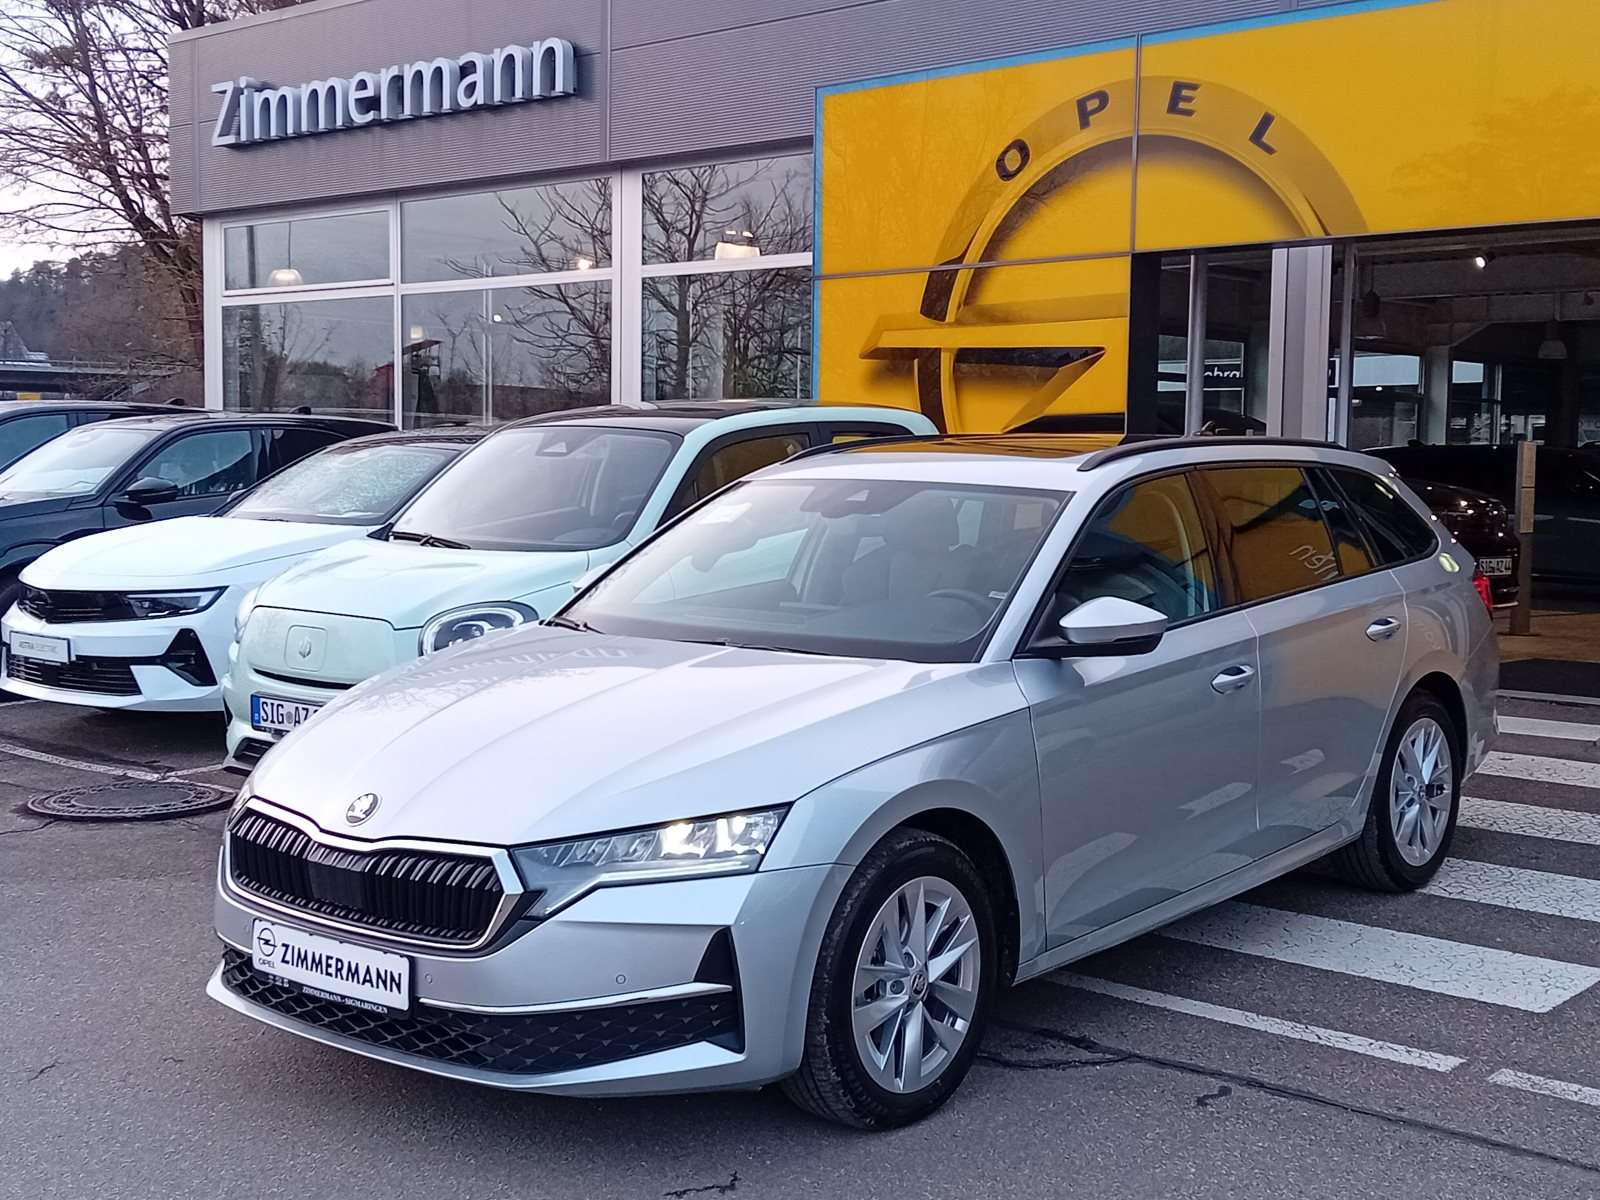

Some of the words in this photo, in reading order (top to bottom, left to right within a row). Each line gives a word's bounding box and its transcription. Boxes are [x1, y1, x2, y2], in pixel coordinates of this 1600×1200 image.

[211, 36, 575, 147] Zimmermann
[995, 80, 1278, 182] OPEL
[261, 701, 285, 725] SIG
[258, 957, 276, 969] OPEL
[280, 942, 402, 995] ZIMMERMANN
